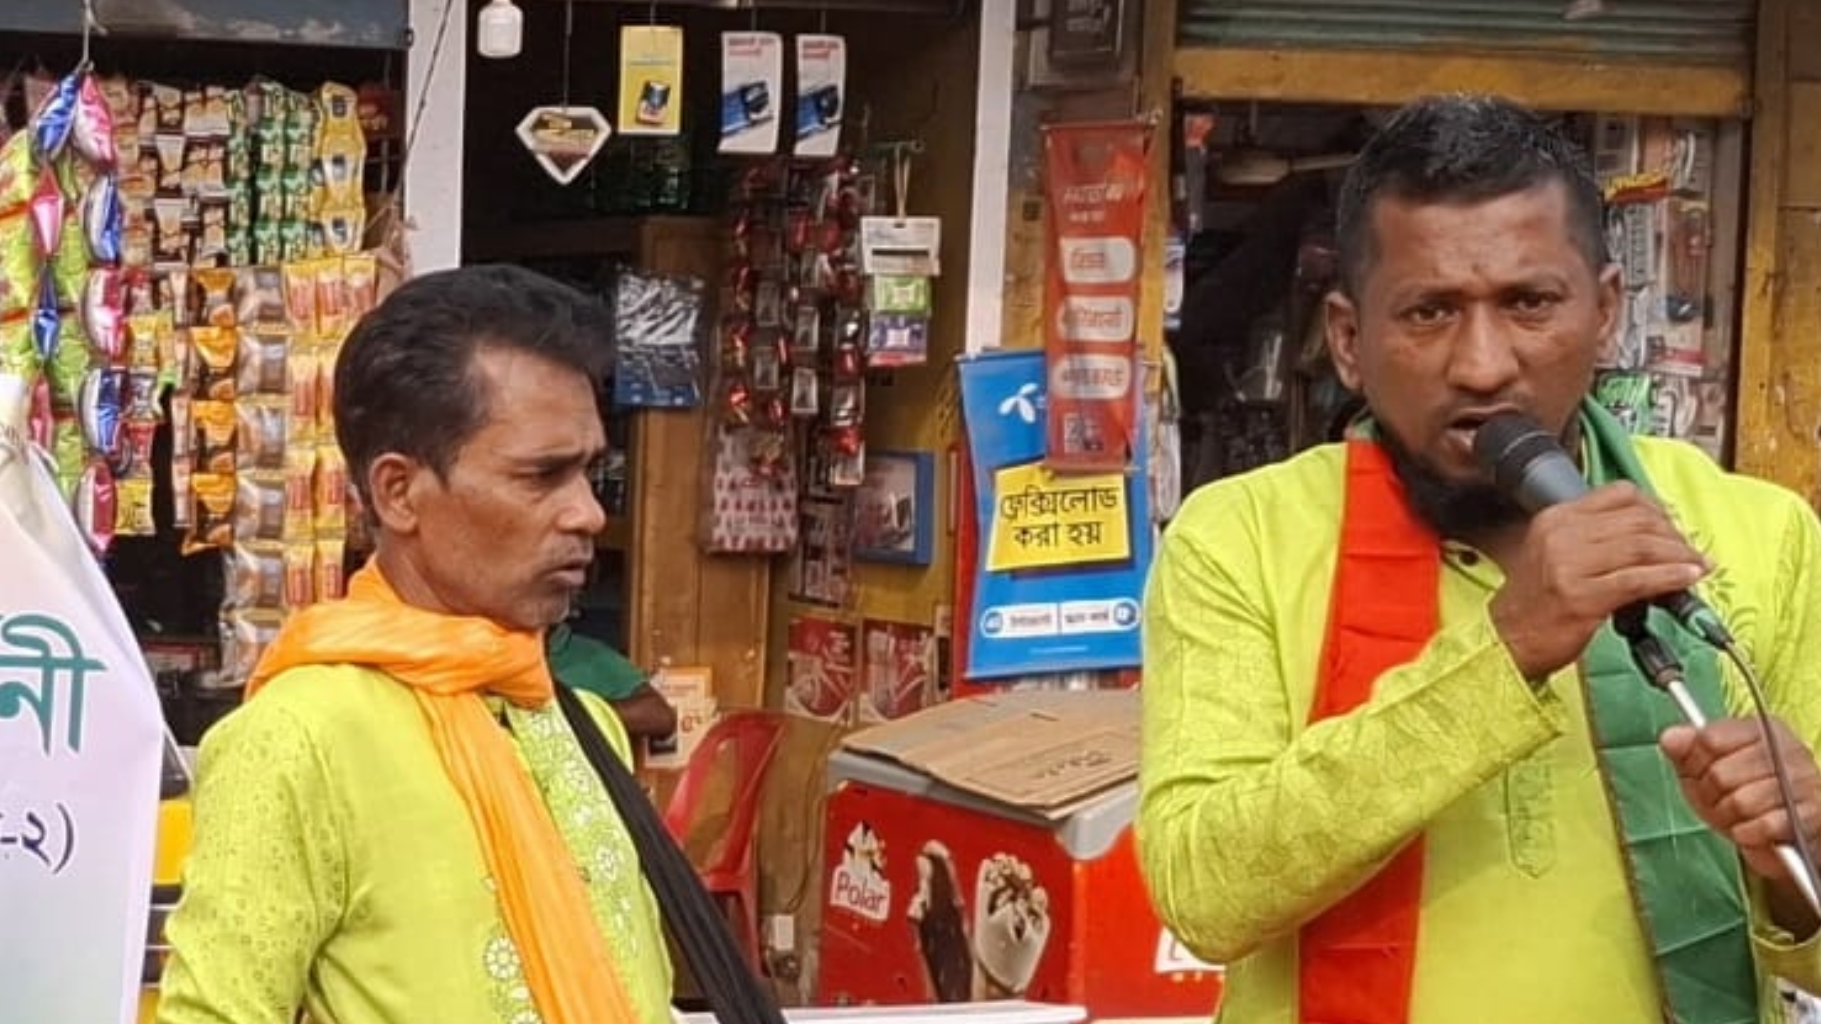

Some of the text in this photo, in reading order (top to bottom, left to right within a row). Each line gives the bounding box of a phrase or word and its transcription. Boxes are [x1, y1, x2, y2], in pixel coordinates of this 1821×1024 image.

[1013, 520, 1104, 548] করা হয়
[836, 870, 887, 914] Polar
